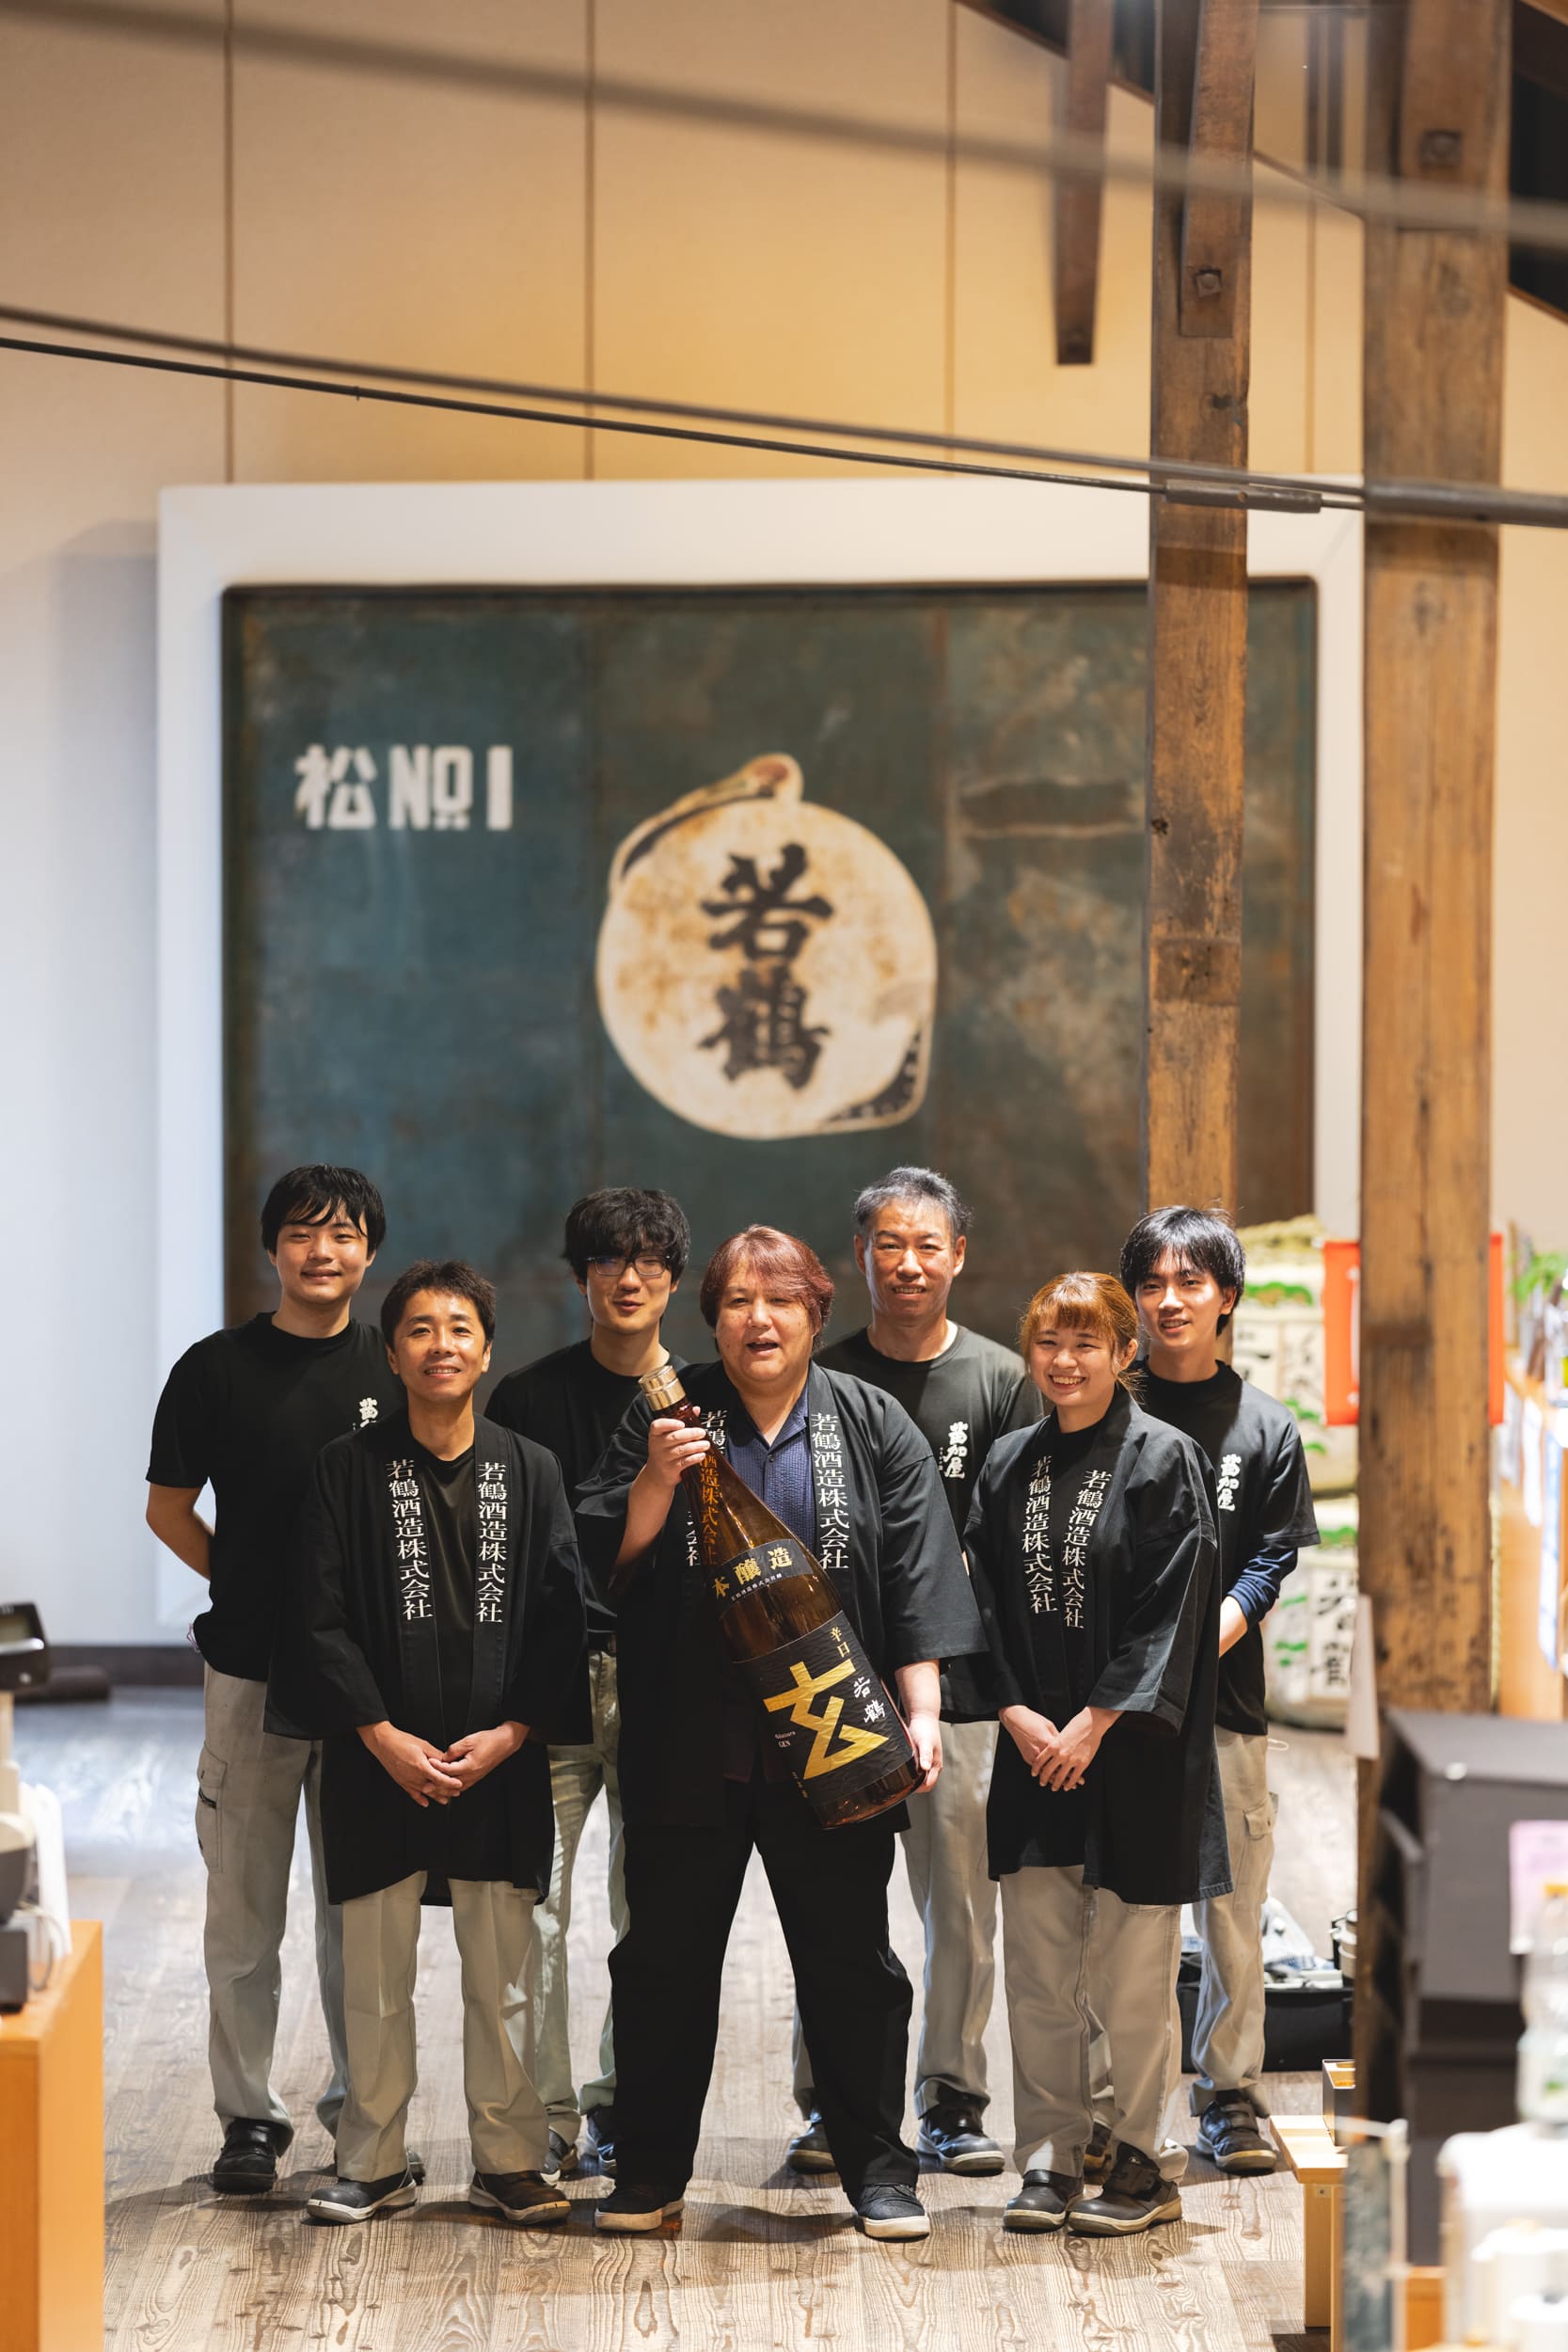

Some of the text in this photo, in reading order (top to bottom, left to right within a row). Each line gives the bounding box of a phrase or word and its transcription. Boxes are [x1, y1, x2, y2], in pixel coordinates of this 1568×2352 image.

[294, 743, 376, 830] 松
[698, 843, 832, 1090] 若鶴
[811, 1412, 849, 1569] 若鶴酒造株式会社
[942, 1422, 969, 1479] 苗加屋
[386, 1459, 434, 1620] 若鶴酒造株式会社
[476, 1462, 509, 1623] 若鶴酒造株式会社
[1022, 1455, 1058, 1613] 若鶴酒造株式会社
[1061, 1470, 1113, 1629] 若鶴酒造株式会社
[763, 1659, 889, 1780] 玄
[853, 1677, 886, 1724] 若鶴
